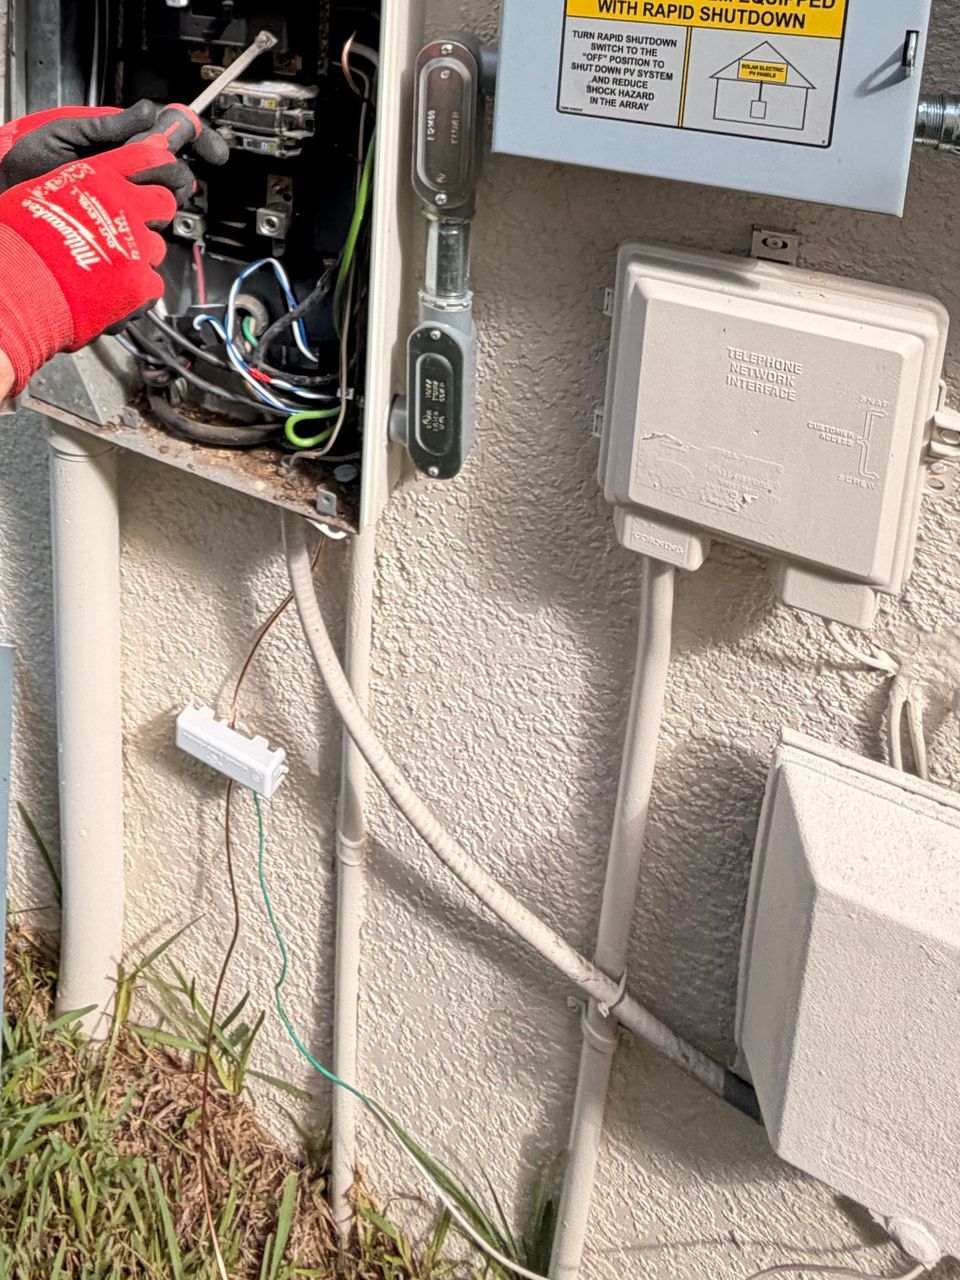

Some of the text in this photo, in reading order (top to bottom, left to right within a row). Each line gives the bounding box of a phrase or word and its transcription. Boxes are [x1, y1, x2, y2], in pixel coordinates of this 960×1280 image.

[598, 0, 806, 29] WITH RAPID SHUTDOWN
[573, 30, 677, 47] TURN RAPID SHUTDOWN
[591, 43, 657, 56] SWITCH TO THE
[610, 55, 650, 68] POSITION
[653, 59, 664, 68] TO
[742, 63, 784, 73] SOLAR ELECTRIC
[571, 62, 673, 81] SHUT DOWN PV SYSTEM
[592, 76, 648, 89] AND REDUCE
[586, 85, 654, 100] SHOCK HAZARD
[590, 97, 649, 111] IN THE ARRAY
[21, 200, 100, 271] Milwaukee
[727, 347, 803, 375] TELEPHONE
[730, 362, 796, 389] NETWORK
[726, 375, 796, 401] INTERFACE
[858, 395, 890, 408] SNAP
[807, 421, 855, 439] CUSTOMER
[819, 432, 854, 447] ACCESS
[838, 474, 875, 489] SCREW
